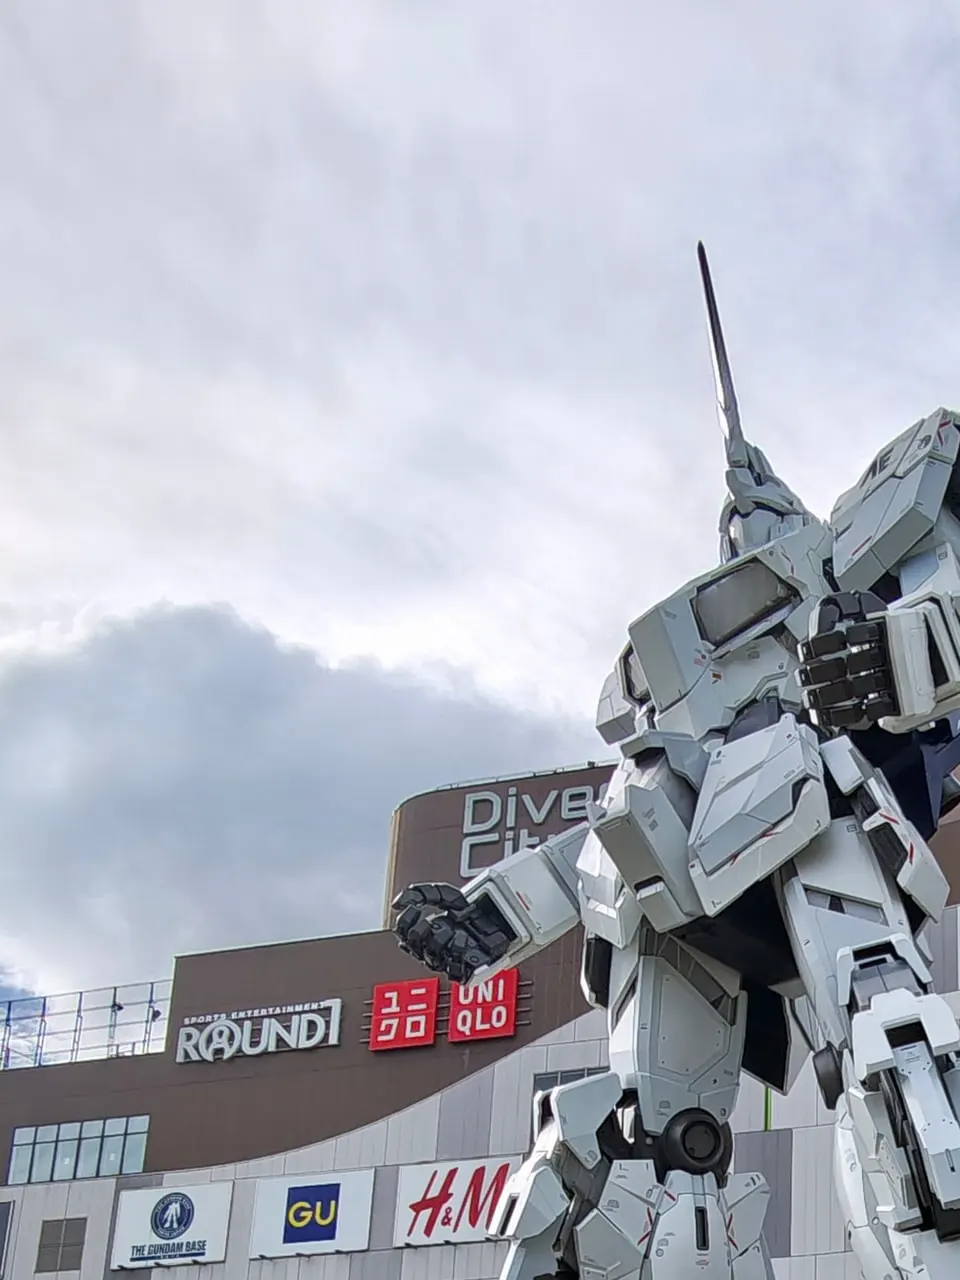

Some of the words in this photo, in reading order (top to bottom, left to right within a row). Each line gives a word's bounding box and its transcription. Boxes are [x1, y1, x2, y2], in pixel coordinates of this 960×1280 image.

[460, 828, 557, 878] Cit
[381, 987, 428, 1014] ユニ
[459, 979, 505, 1005] UNI
[184, 1013, 227, 1025] SPORTS
[231, 1001, 326, 1019] ENTERTAINMENT
[457, 1005, 507, 1036] QLO
[377, 1015, 426, 1042] クロ
[288, 1200, 336, 1228] GU
[407, 1163, 510, 1238] H&M
[131, 1244, 146, 1256] THE
[147, 1242, 184, 1255] GUNDAM
[185, 1240, 207, 1252] BASE
